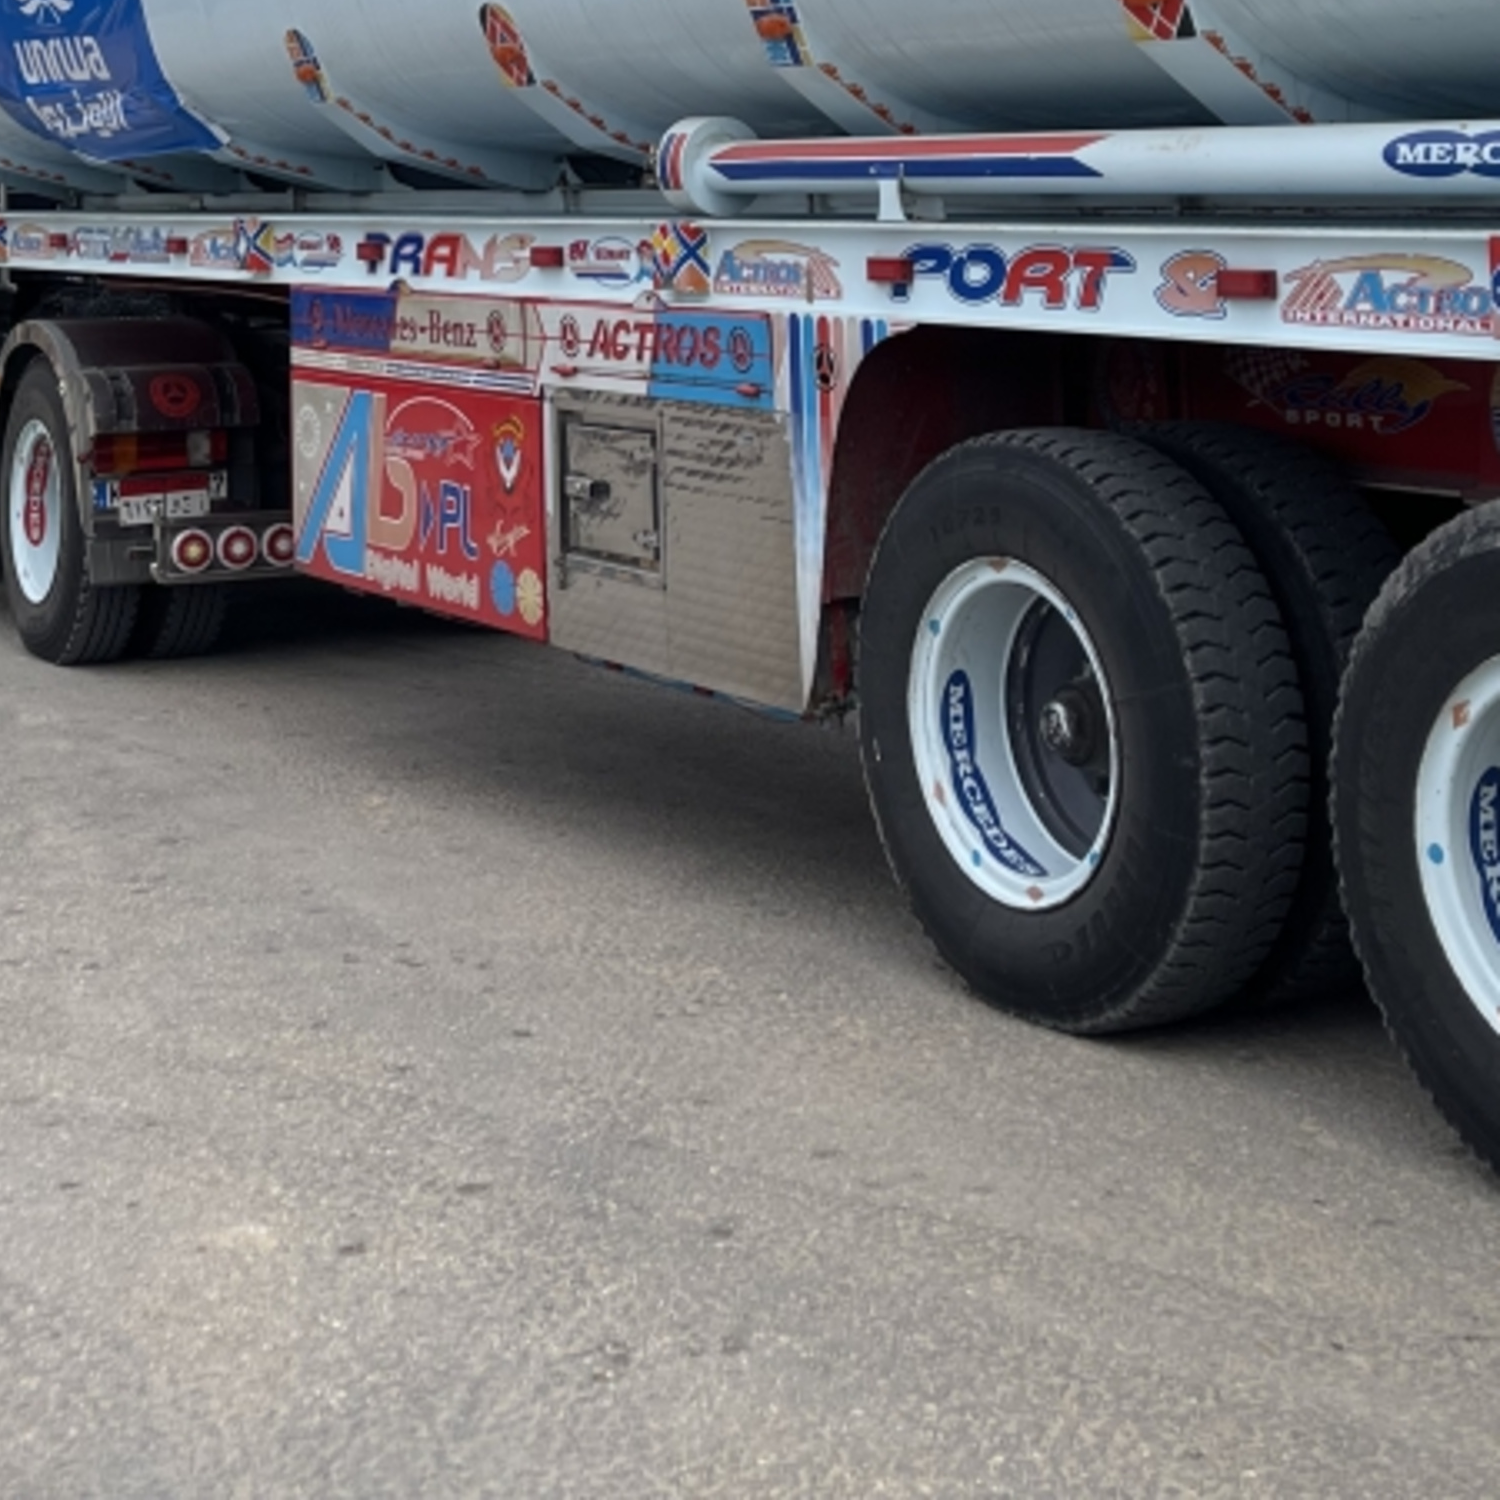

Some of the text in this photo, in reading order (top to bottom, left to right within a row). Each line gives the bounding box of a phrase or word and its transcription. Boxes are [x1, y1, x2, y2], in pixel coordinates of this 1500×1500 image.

[589, 318, 722, 370] ACTROS
[1285, 408, 1385, 433] SPORT
[426, 561, 480, 612] World
